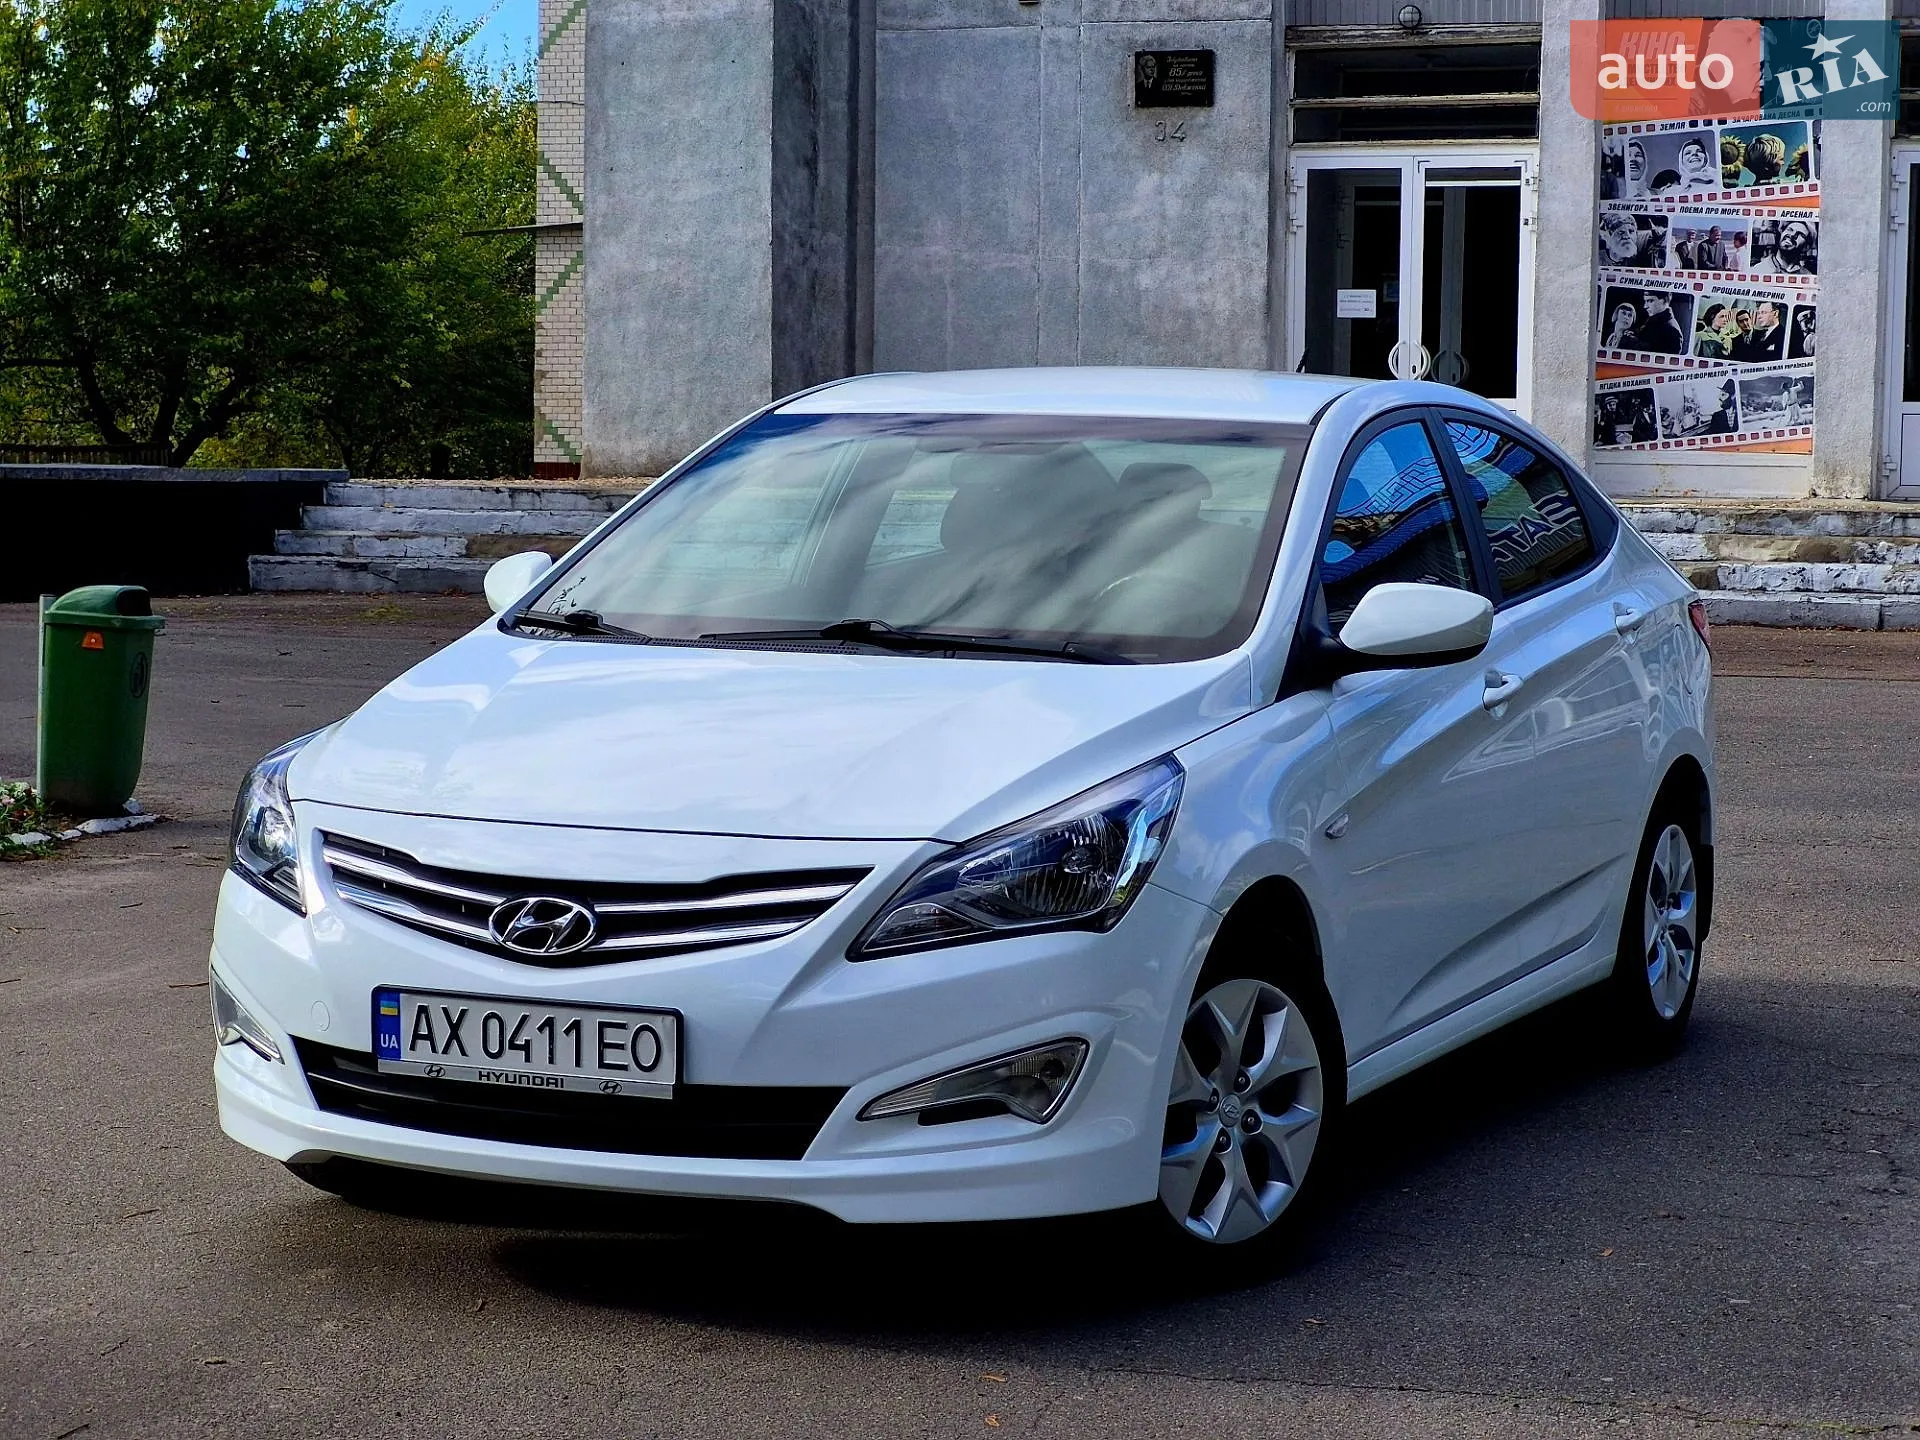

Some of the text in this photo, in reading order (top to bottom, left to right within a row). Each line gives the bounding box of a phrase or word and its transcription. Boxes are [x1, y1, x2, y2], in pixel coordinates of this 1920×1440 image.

[1732, 110, 1801, 123] ЗАЧАРОВАНА ДЕСНА
[1659, 121, 1686, 131] ЗЕМЛЯ
[1607, 202, 1649, 212] ЗВЕНИГОРА
[1679, 205, 1740, 216] ПОЕМА ПРО МОРЕ
[1780, 209, 1813, 219] АРСЕНАЛ
[1619, 276, 1644, 286] СУМКА
[1685, 369, 1729, 381] РЕФОРМАТОР
[1622, 378, 1651, 388] КОХАННЯ
[380, 1033, 399, 1049] UA
[408, 1003, 663, 1073] AX 0411 EO
[478, 1070, 565, 1089] HYUNDAI
